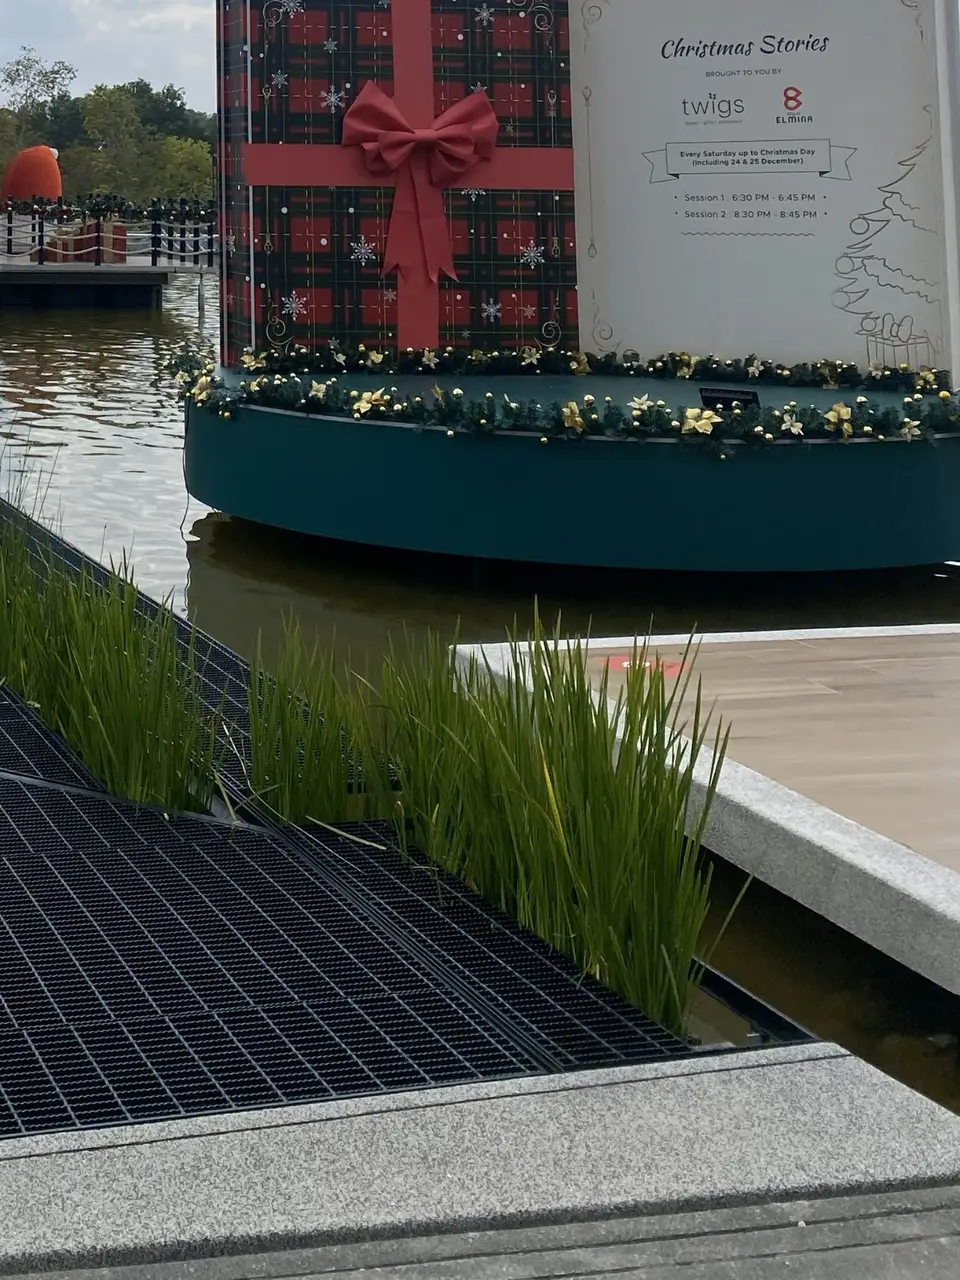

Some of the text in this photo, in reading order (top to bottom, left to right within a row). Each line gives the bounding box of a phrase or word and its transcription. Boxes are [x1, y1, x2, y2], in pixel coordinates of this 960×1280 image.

[660, 34, 830, 59] Christmas Stories
[705, 70, 740, 78] BROUGHT
[681, 93, 745, 119] twigs
[702, 150, 736, 158] Saturday
[800, 148, 816, 156] Day
[761, 157, 804, 165] December)
[684, 194, 718, 202] Session
[684, 210, 718, 218] Session
[757, 210, 771, 218] PM
[780, 210, 801, 218] 8:45
[803, 210, 817, 218] PM
